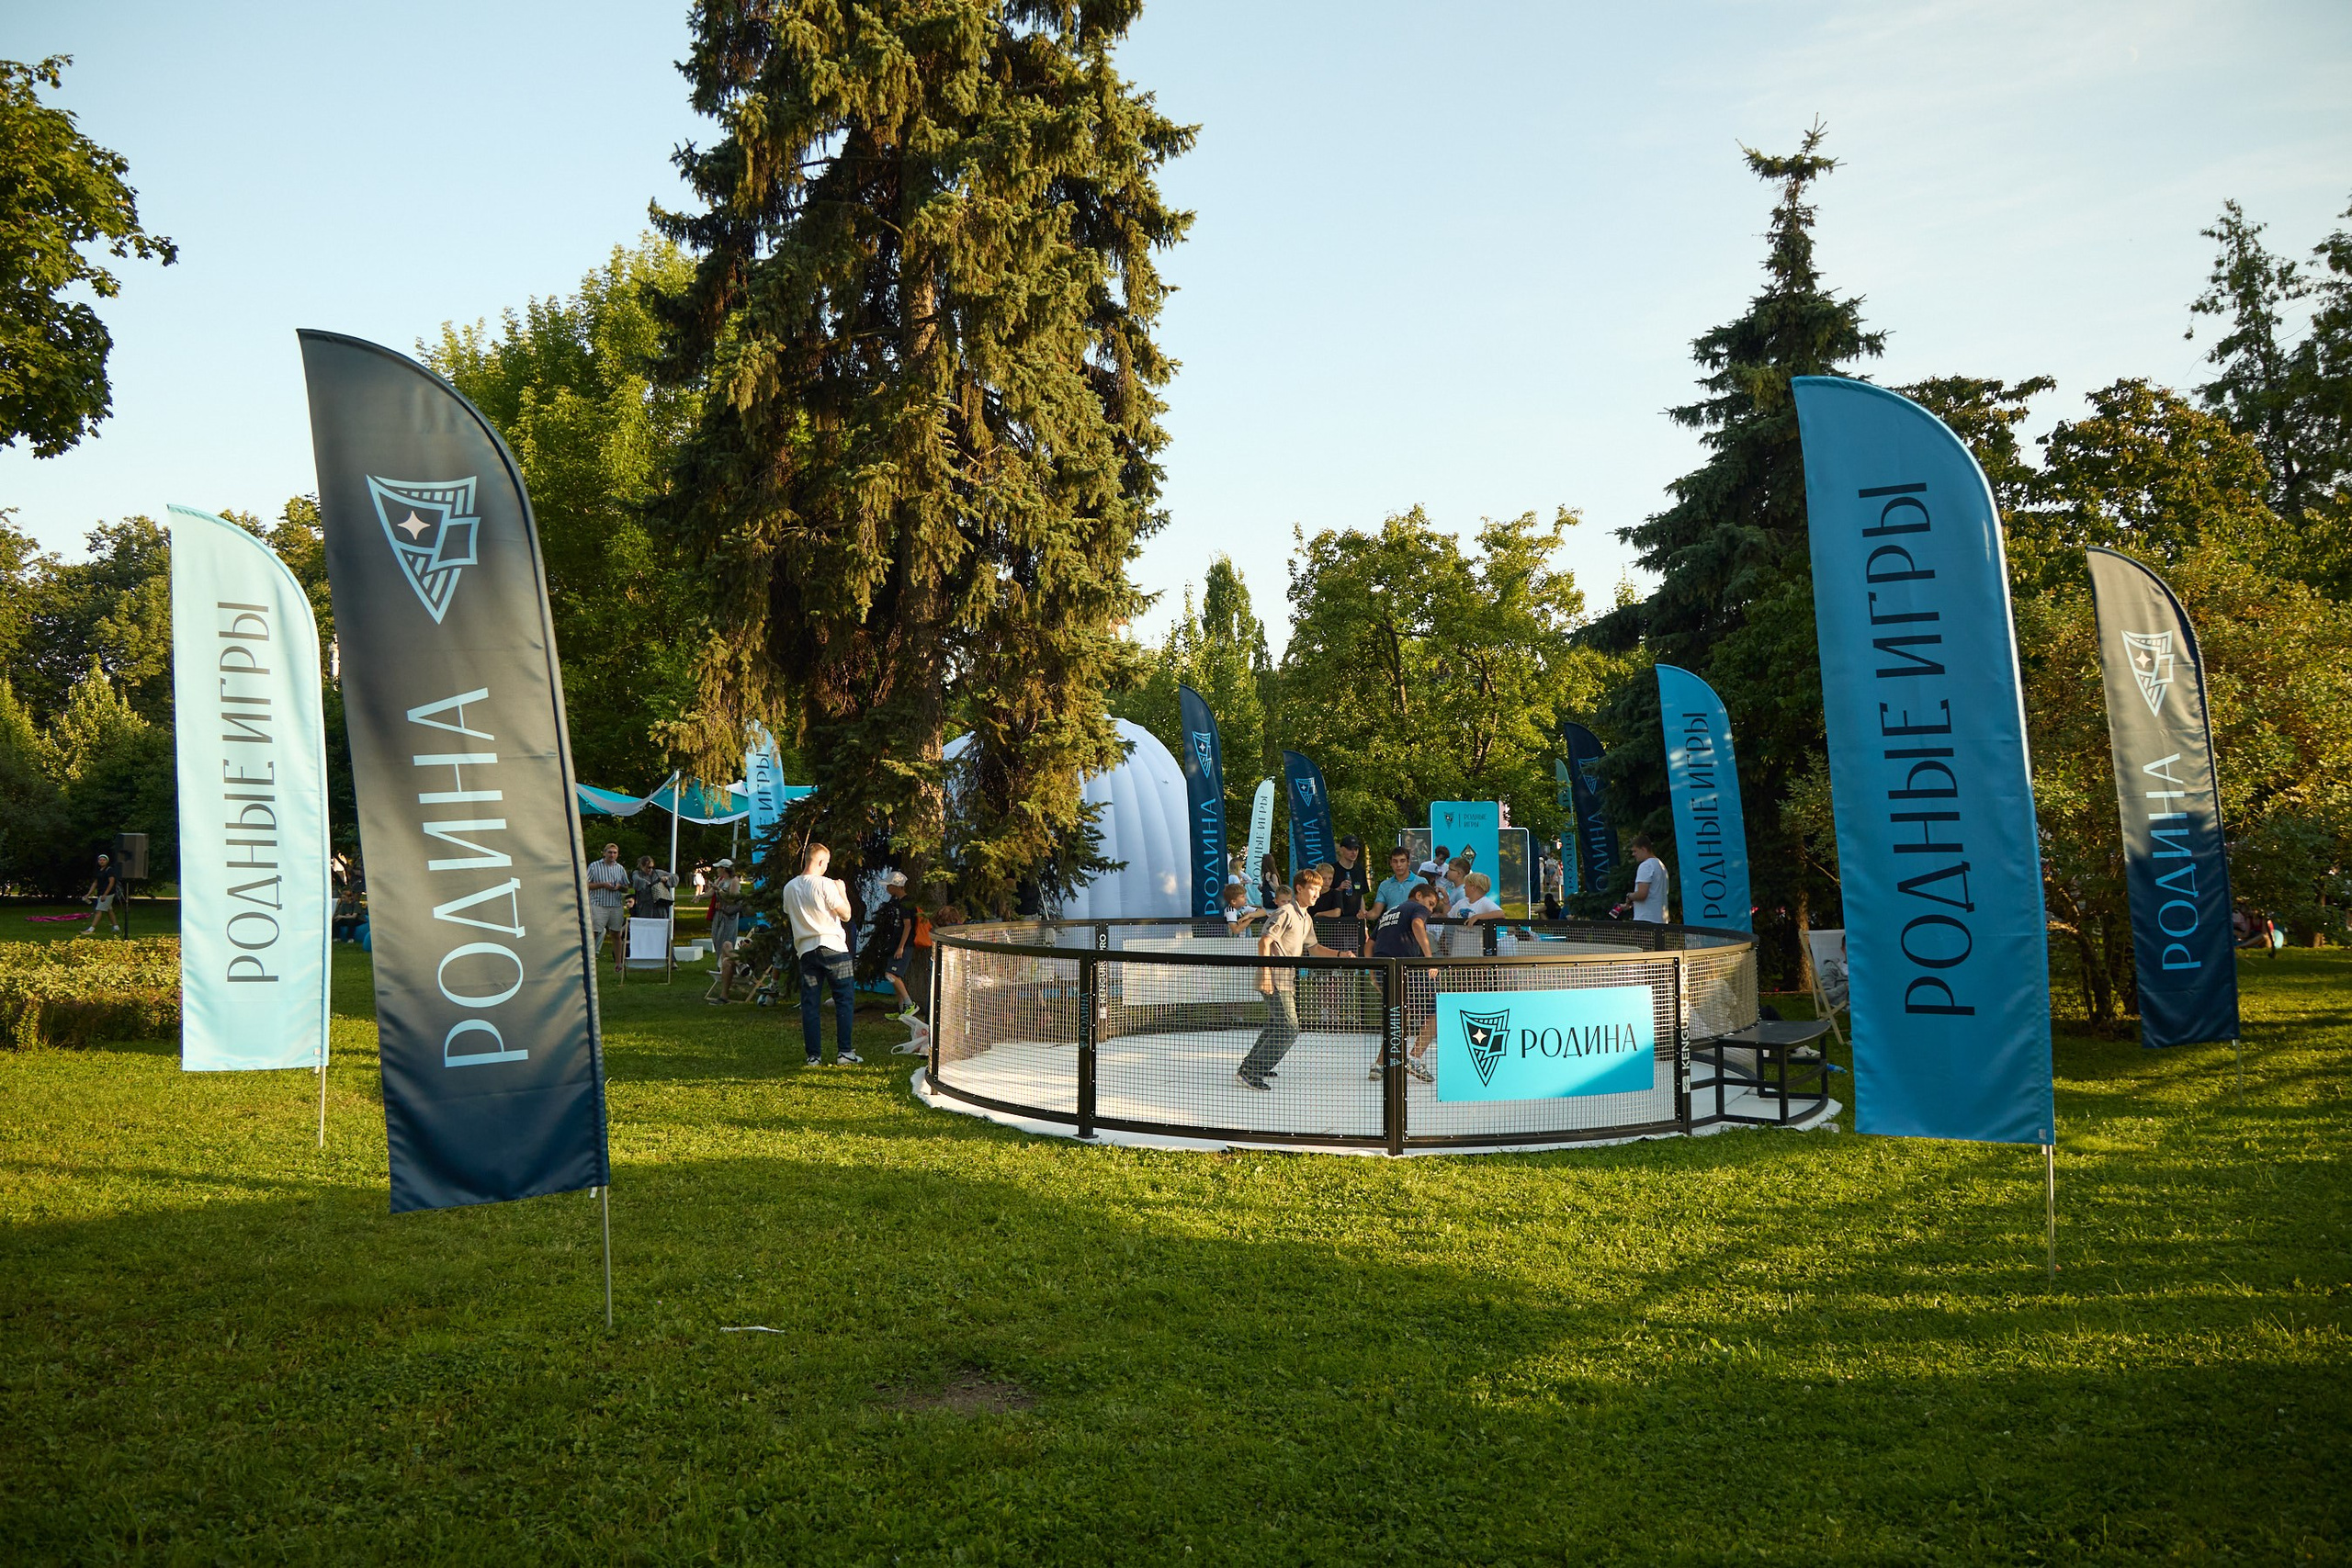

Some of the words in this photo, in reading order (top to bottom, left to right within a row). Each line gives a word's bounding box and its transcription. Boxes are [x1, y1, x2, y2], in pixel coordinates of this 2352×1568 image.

[1859, 482, 1946, 679] ИГРЫ
[217, 602, 273, 743] ИГРЫ
[756, 752, 774, 811] ИГРЫ
[1682, 713, 1715, 789] ИГРЫ
[1201, 798, 1219, 915] РОДИНА
[1257, 795, 1268, 829] ИГРЫ
[1588, 811, 1611, 891] ОДИНА
[1692, 797, 1727, 919] РОДНЫЕ
[1879, 699, 1975, 1017] РОДНЫЕ
[223, 759, 283, 983] РОДНЫЕ
[407, 687, 528, 1068] РОДИНА
[2142, 752, 2202, 972] РОДИНА
[1679, 964, 1689, 993] PRO
[1390, 1006, 1401, 1054] РОДИНА
[1521, 1023, 1637, 1058] РОДИНА
[1680, 999, 1690, 1070] KENGURU
